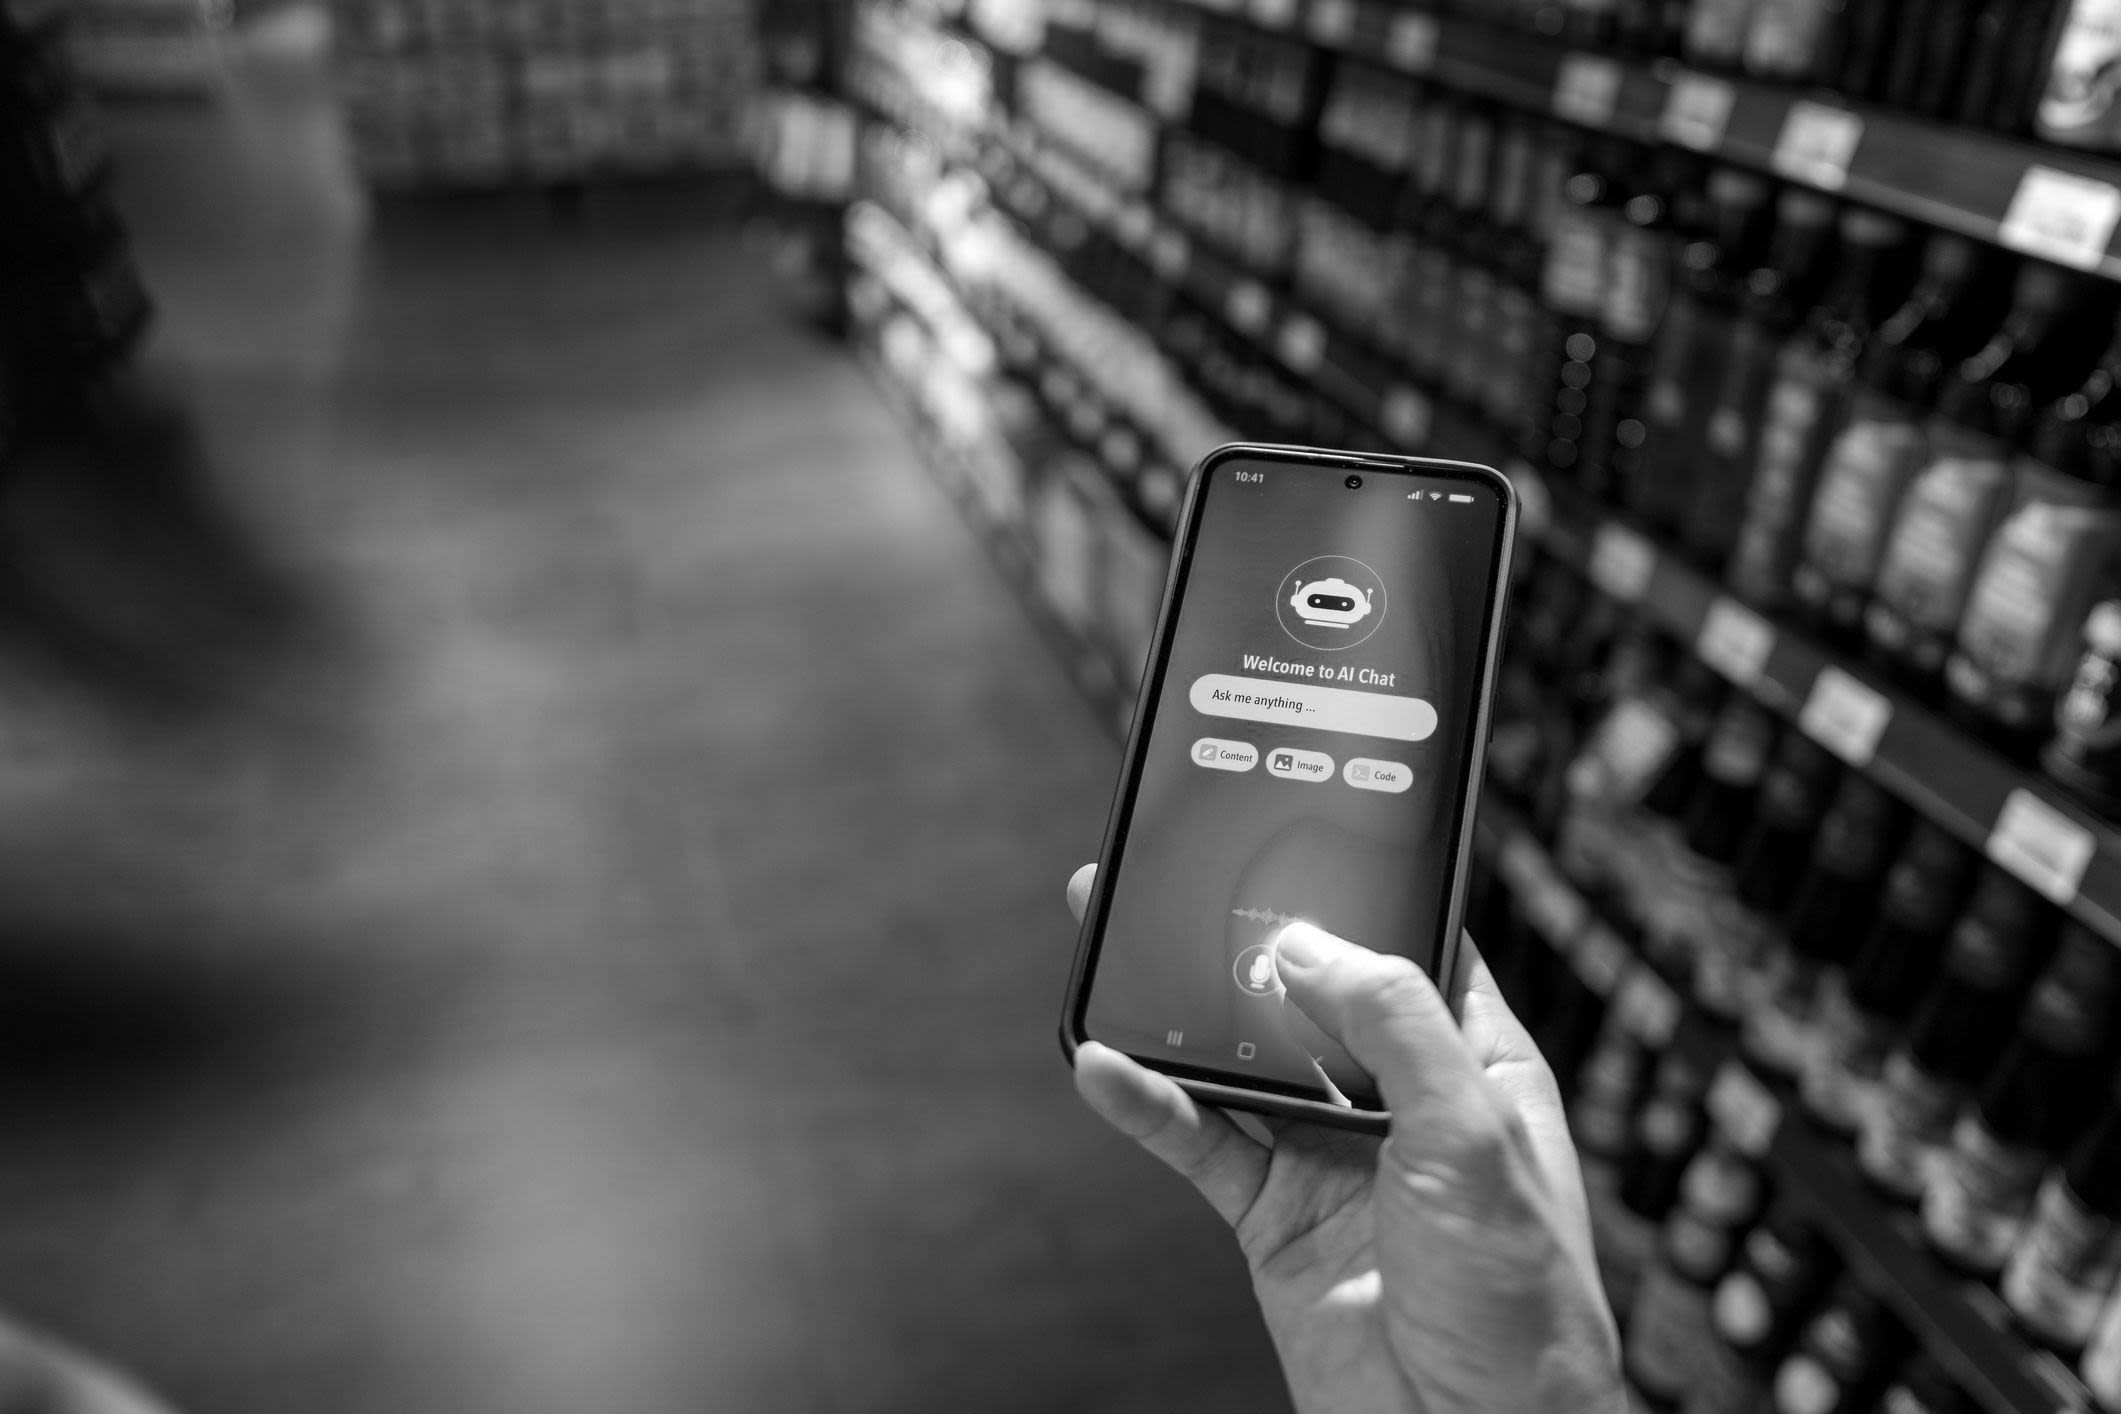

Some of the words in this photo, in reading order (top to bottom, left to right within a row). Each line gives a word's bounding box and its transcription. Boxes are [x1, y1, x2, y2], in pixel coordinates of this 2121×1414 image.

[1235, 471, 1264, 483] 10:41
[1243, 655, 1315, 677] Welcome
[1319, 664, 1334, 679] to
[1338, 665, 1354, 681] AI
[1359, 667, 1396, 687] Chat
[1212, 689, 1231, 701] Ask
[1234, 693, 1251, 704] me
[1254, 695, 1303, 713] anything
[1220, 750, 1253, 763] Content
[1297, 760, 1324, 774] Image
[1375, 771, 1396, 782] Code
